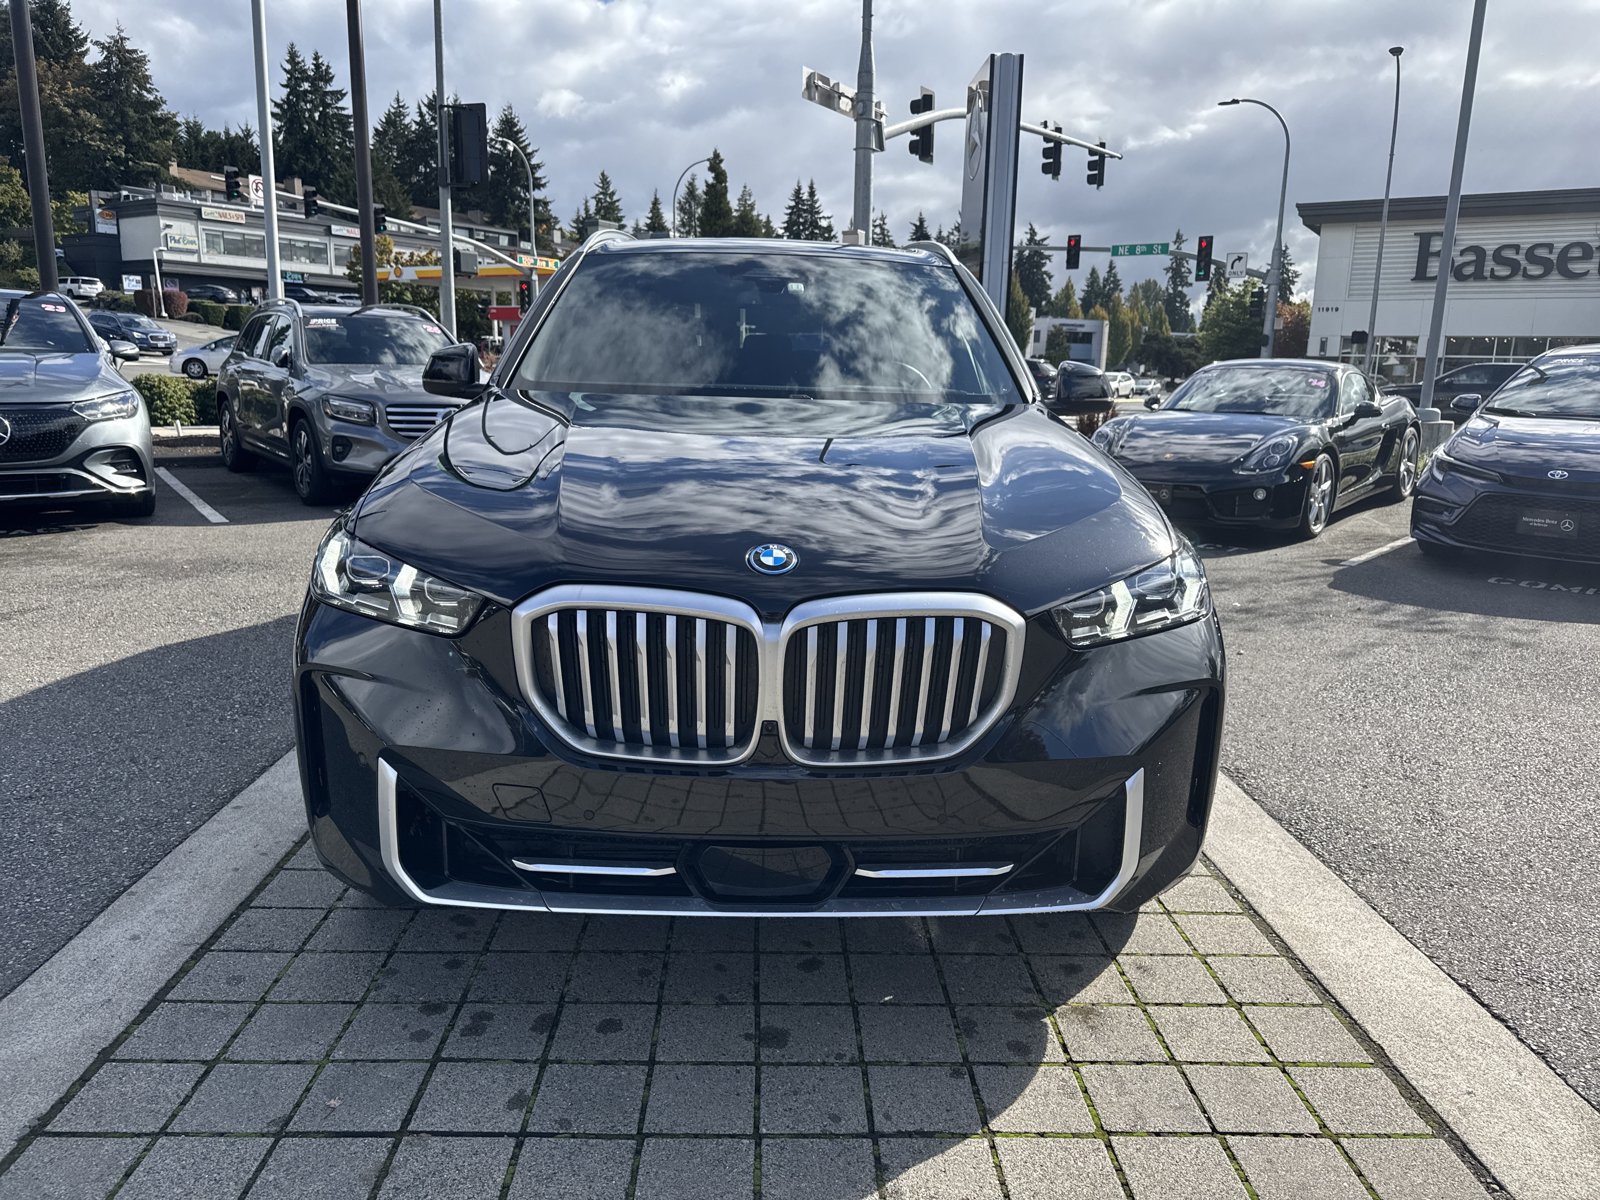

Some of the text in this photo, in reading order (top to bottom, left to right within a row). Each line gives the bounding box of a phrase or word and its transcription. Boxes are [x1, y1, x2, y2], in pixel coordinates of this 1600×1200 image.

[1118, 244, 1162, 256] NE 8th St
[1410, 231, 1600, 282] Basse
